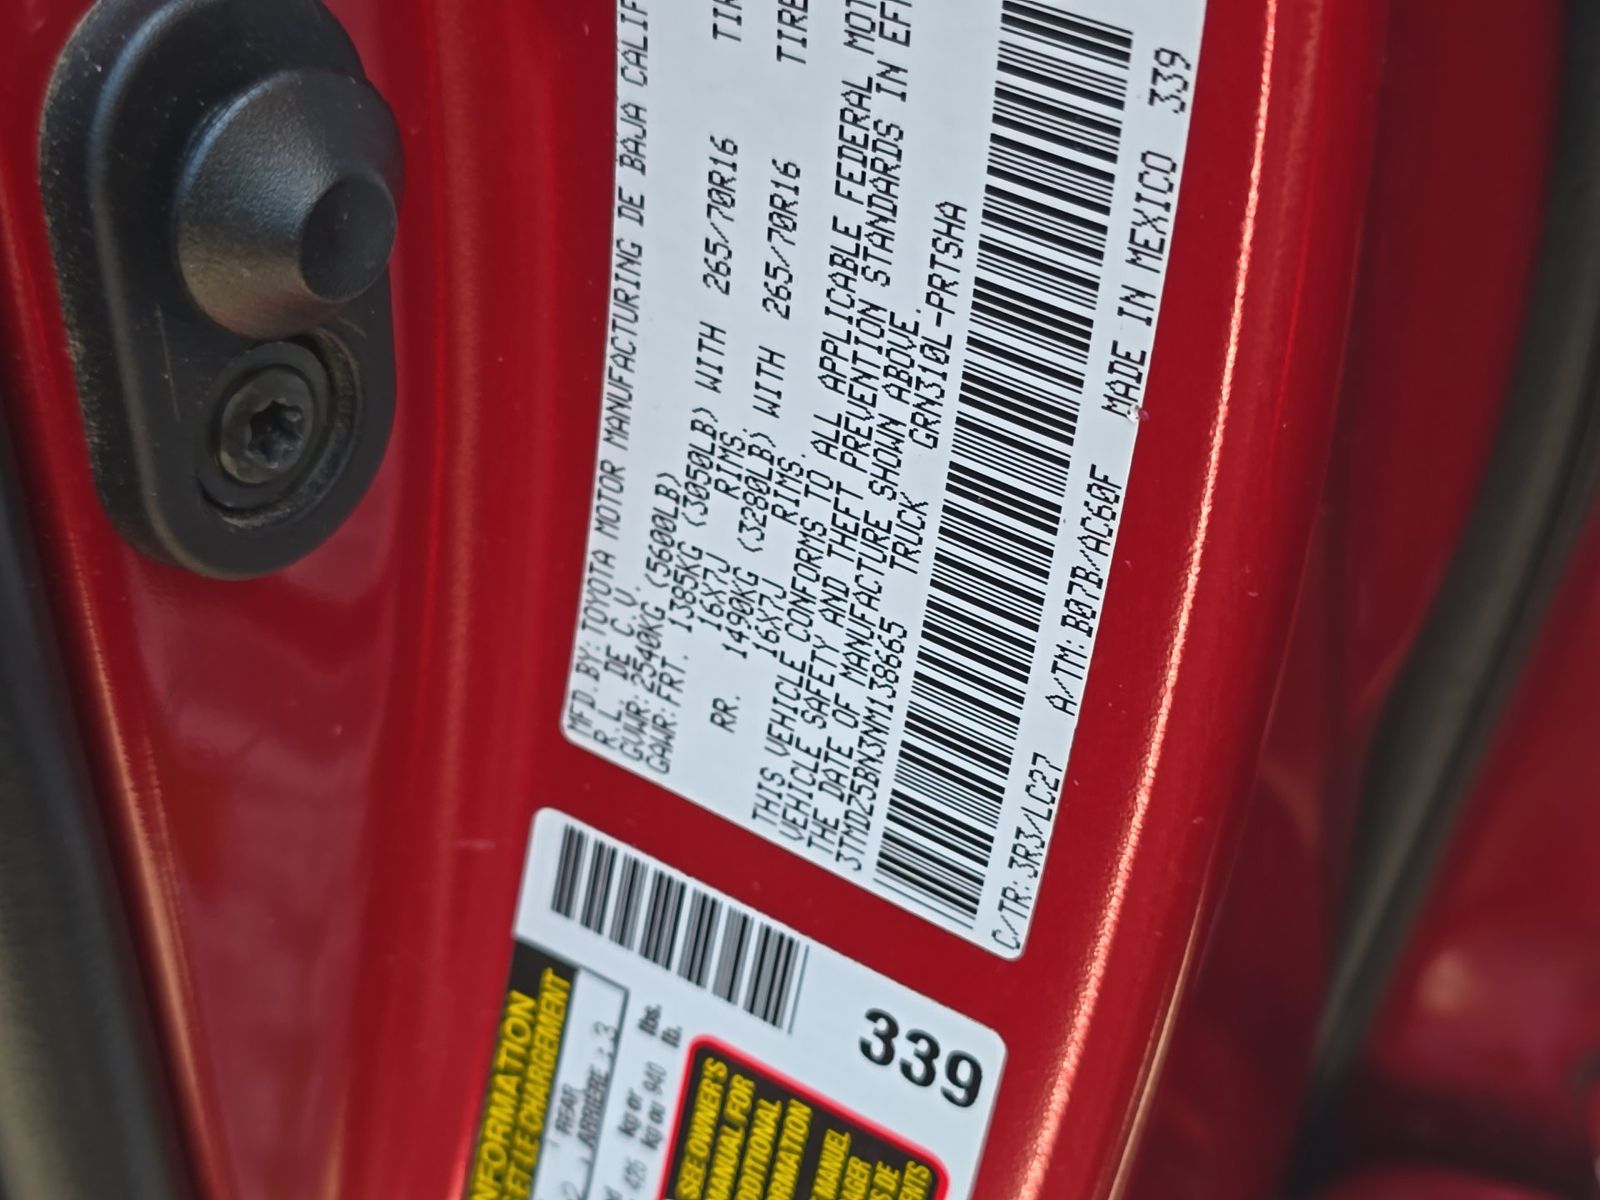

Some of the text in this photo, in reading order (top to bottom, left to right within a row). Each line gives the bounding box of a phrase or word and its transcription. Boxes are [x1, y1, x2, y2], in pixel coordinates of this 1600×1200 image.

[1148, 47, 1192, 114] 339
[619, 100, 648, 176] BAJA
[834, 75, 874, 207] FEDERAL
[617, 186, 645, 227] DE
[702, 134, 739, 296] 265/70R16
[762, 158, 801, 320] 265/70R16
[1126, 150, 1177, 274] MEXICO
[602, 237, 643, 451] MANUFACTURING
[694, 320, 727, 394] WITH
[817, 215, 863, 396] APPLICABLE
[1117, 284, 1157, 327] IN
[752, 345, 787, 420] WITH
[779, 0, 912, 842] VEHICLE SAFETY AND THEFT PREVENTION STANDARDS IN EF
[1101, 339, 1147, 420] MADE
[681, 406, 719, 527] (3050LB)
[803, 468, 834, 504] TO
[810, 412, 843, 461] ALL
[595, 458, 626, 540] MOTOR
[644, 471, 682, 589] (5600LB)
[698, 427, 749, 632] 16X7J RIMS.
[736, 430, 777, 553] (3280LB)
[835, 200, 968, 872] 3TMDZ5BN3NM138665 TRUCK GRN310L-PRTSHA
[669, 539, 703, 634] 1385KG
[752, 453, 806, 658] 16X7J RIMS.
[786, 515, 828, 643] CONFORMS
[807, 308, 921, 857] THE DATE OF MANUFACTURE SHOWN ABOVE.
[603, 644, 632, 681] DE
[721, 566, 760, 660] 1490KG
[710, 694, 741, 734] RR.
[763, 650, 807, 758] VEHICLE
[752, 766, 787, 827] THIS
[518, 966, 572, 1133] CHARGEMENT
[724, 1073, 756, 1126] FOR
[859, 1006, 984, 1109] 339
[677, 1056, 729, 1198] SEE OWNER'S
[873, 1161, 900, 1192] DE
